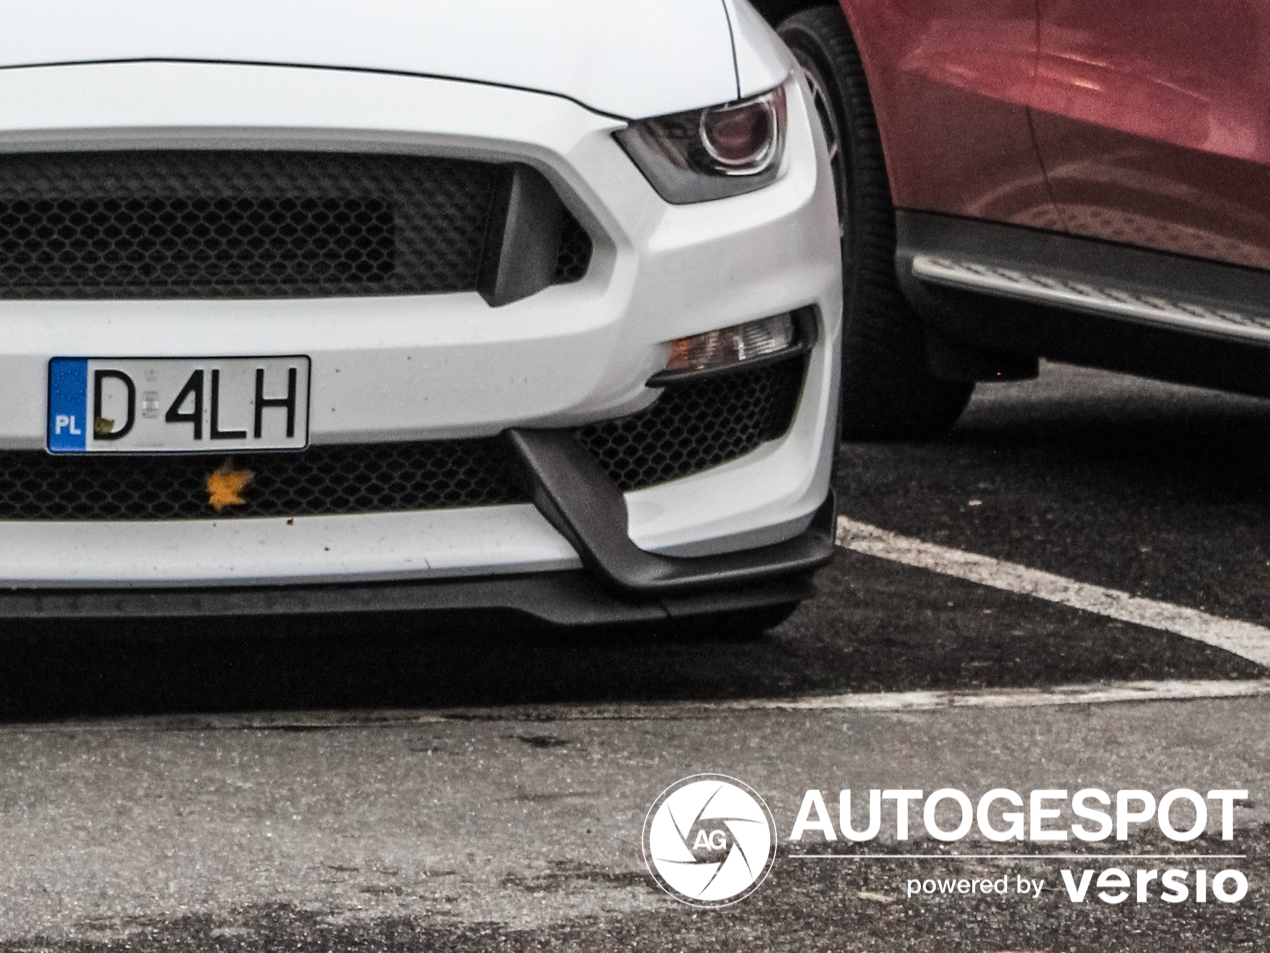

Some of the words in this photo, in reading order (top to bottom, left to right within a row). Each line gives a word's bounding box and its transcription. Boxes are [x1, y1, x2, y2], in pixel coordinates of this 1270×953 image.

[54, 414, 82, 436] PL
[92, 369, 137, 441] D
[164, 367, 298, 441] 4LH
